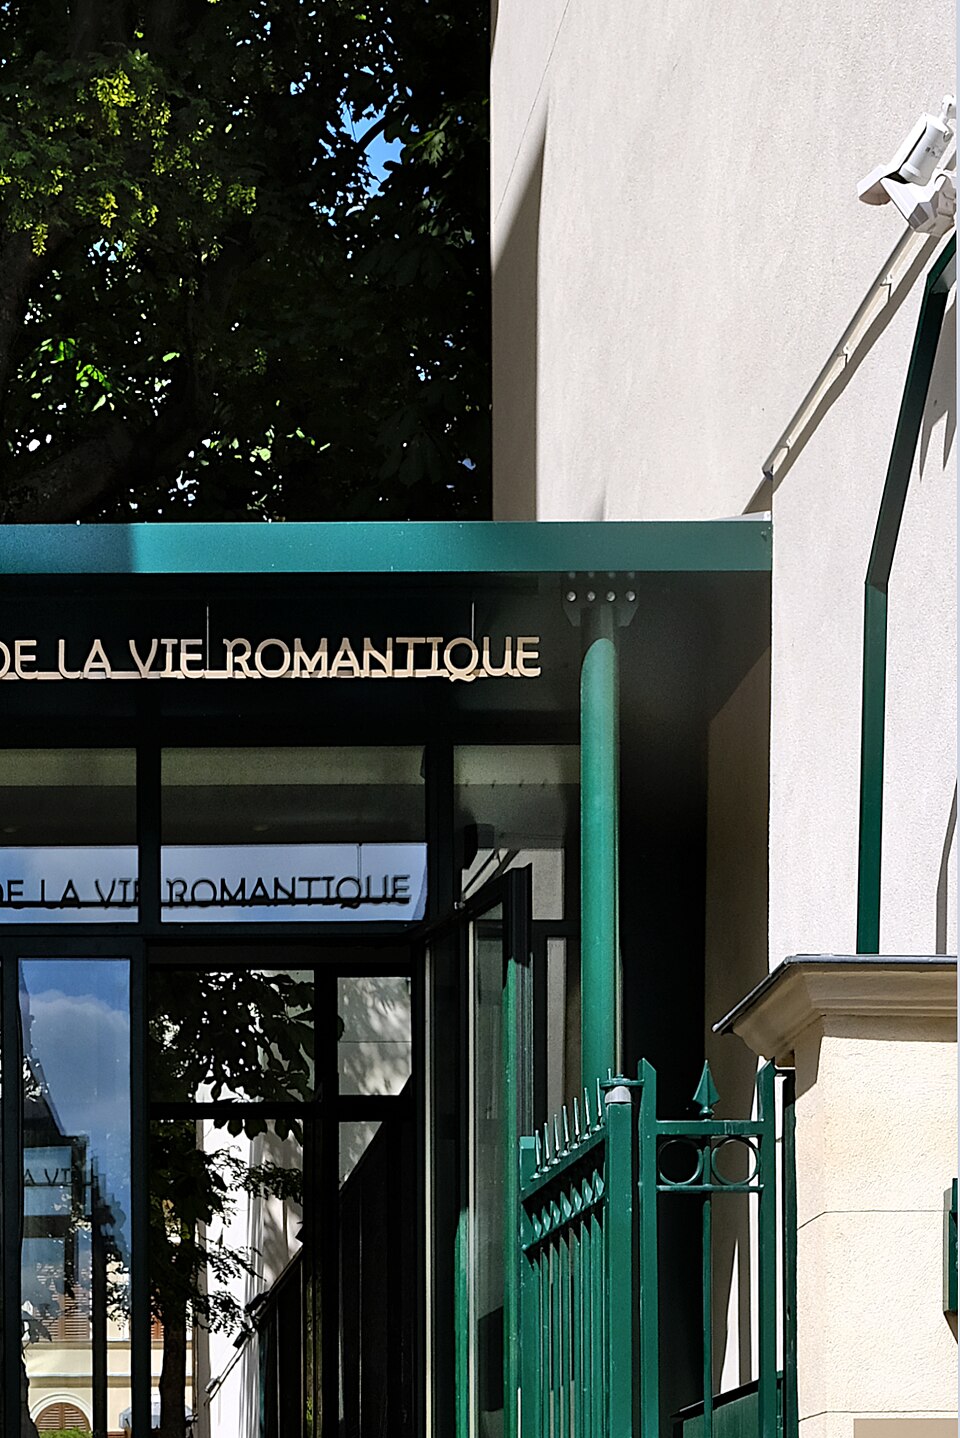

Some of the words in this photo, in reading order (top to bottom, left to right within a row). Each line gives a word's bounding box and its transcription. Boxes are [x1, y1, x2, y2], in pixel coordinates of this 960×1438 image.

[57, 638, 111, 680] LA
[129, 637, 205, 680] VIE
[222, 635, 542, 682] ROMANTIQUE
[41, 879, 81, 909] LA
[166, 876, 412, 909] ROMANTIQUE
